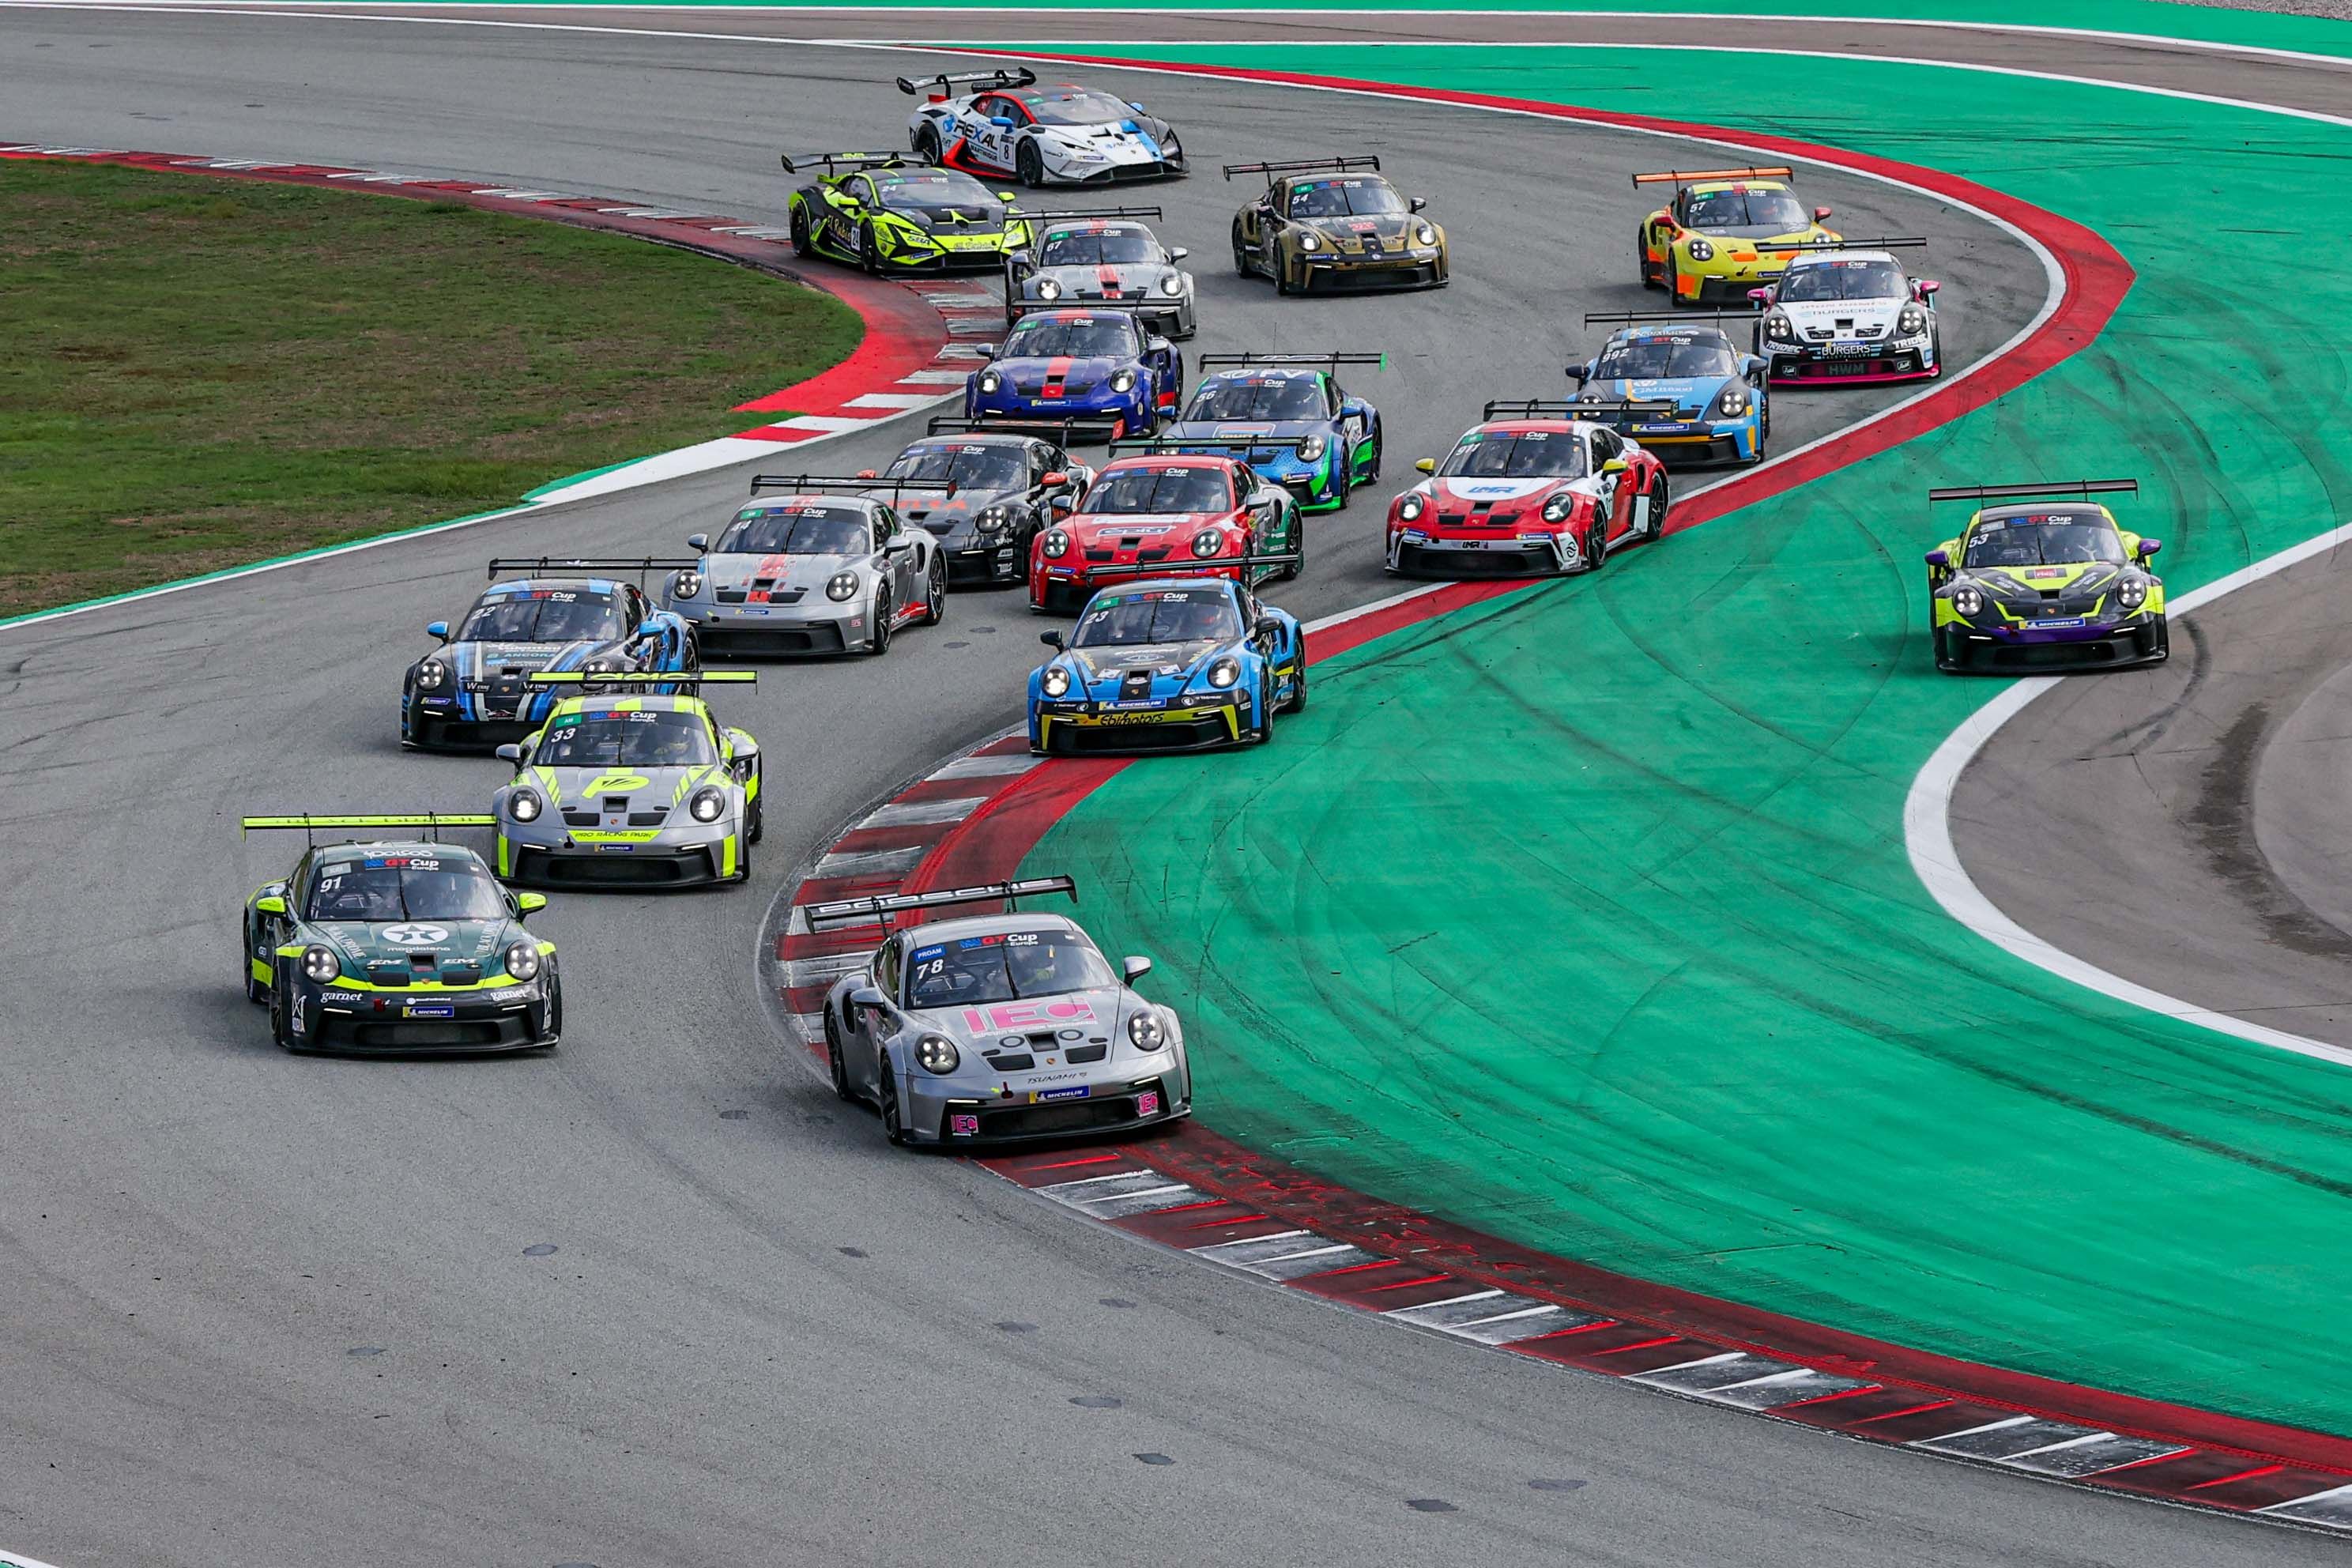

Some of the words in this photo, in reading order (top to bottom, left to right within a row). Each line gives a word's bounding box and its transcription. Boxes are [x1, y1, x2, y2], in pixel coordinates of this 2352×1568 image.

[953, 119, 997, 150] REXAL
[1004, 145, 1009, 160] 8
[1292, 194, 1309, 205] 54
[1690, 202, 1707, 213] 57
[1046, 240, 1062, 252] 67
[1791, 275, 1804, 288] 7
[1766, 340, 1804, 354] TRIDEC
[1892, 332, 1928, 349] TRIDEC
[1602, 349, 1630, 363] 992
[1822, 344, 1871, 356] BURGERS
[1829, 363, 1865, 375] HWM
[1197, 390, 1216, 402] 56
[1456, 443, 1481, 456] 911
[1969, 533, 1989, 548] 53
[472, 606, 496, 620] 22
[1084, 611, 1110, 625] 23
[1117, 699, 1163, 709] MICHELIN
[551, 728, 576, 743] 33
[385, 858, 411, 867] GT
[409, 858, 439, 869] Cup
[320, 877, 342, 893] 91
[819, 879, 1053, 913] PORSCHE
[982, 935, 1008, 946] GT
[1008, 933, 1038, 944] Cup
[918, 948, 943, 959] PROAM
[917, 959, 944, 980] 78
[320, 990, 363, 1004] garnet
[490, 989, 528, 1002] garnet
[1028, 1072, 1077, 1084] TSUNAMI
[1046, 1089, 1084, 1099] MICHELIN
[951, 1114, 979, 1133] IEC
